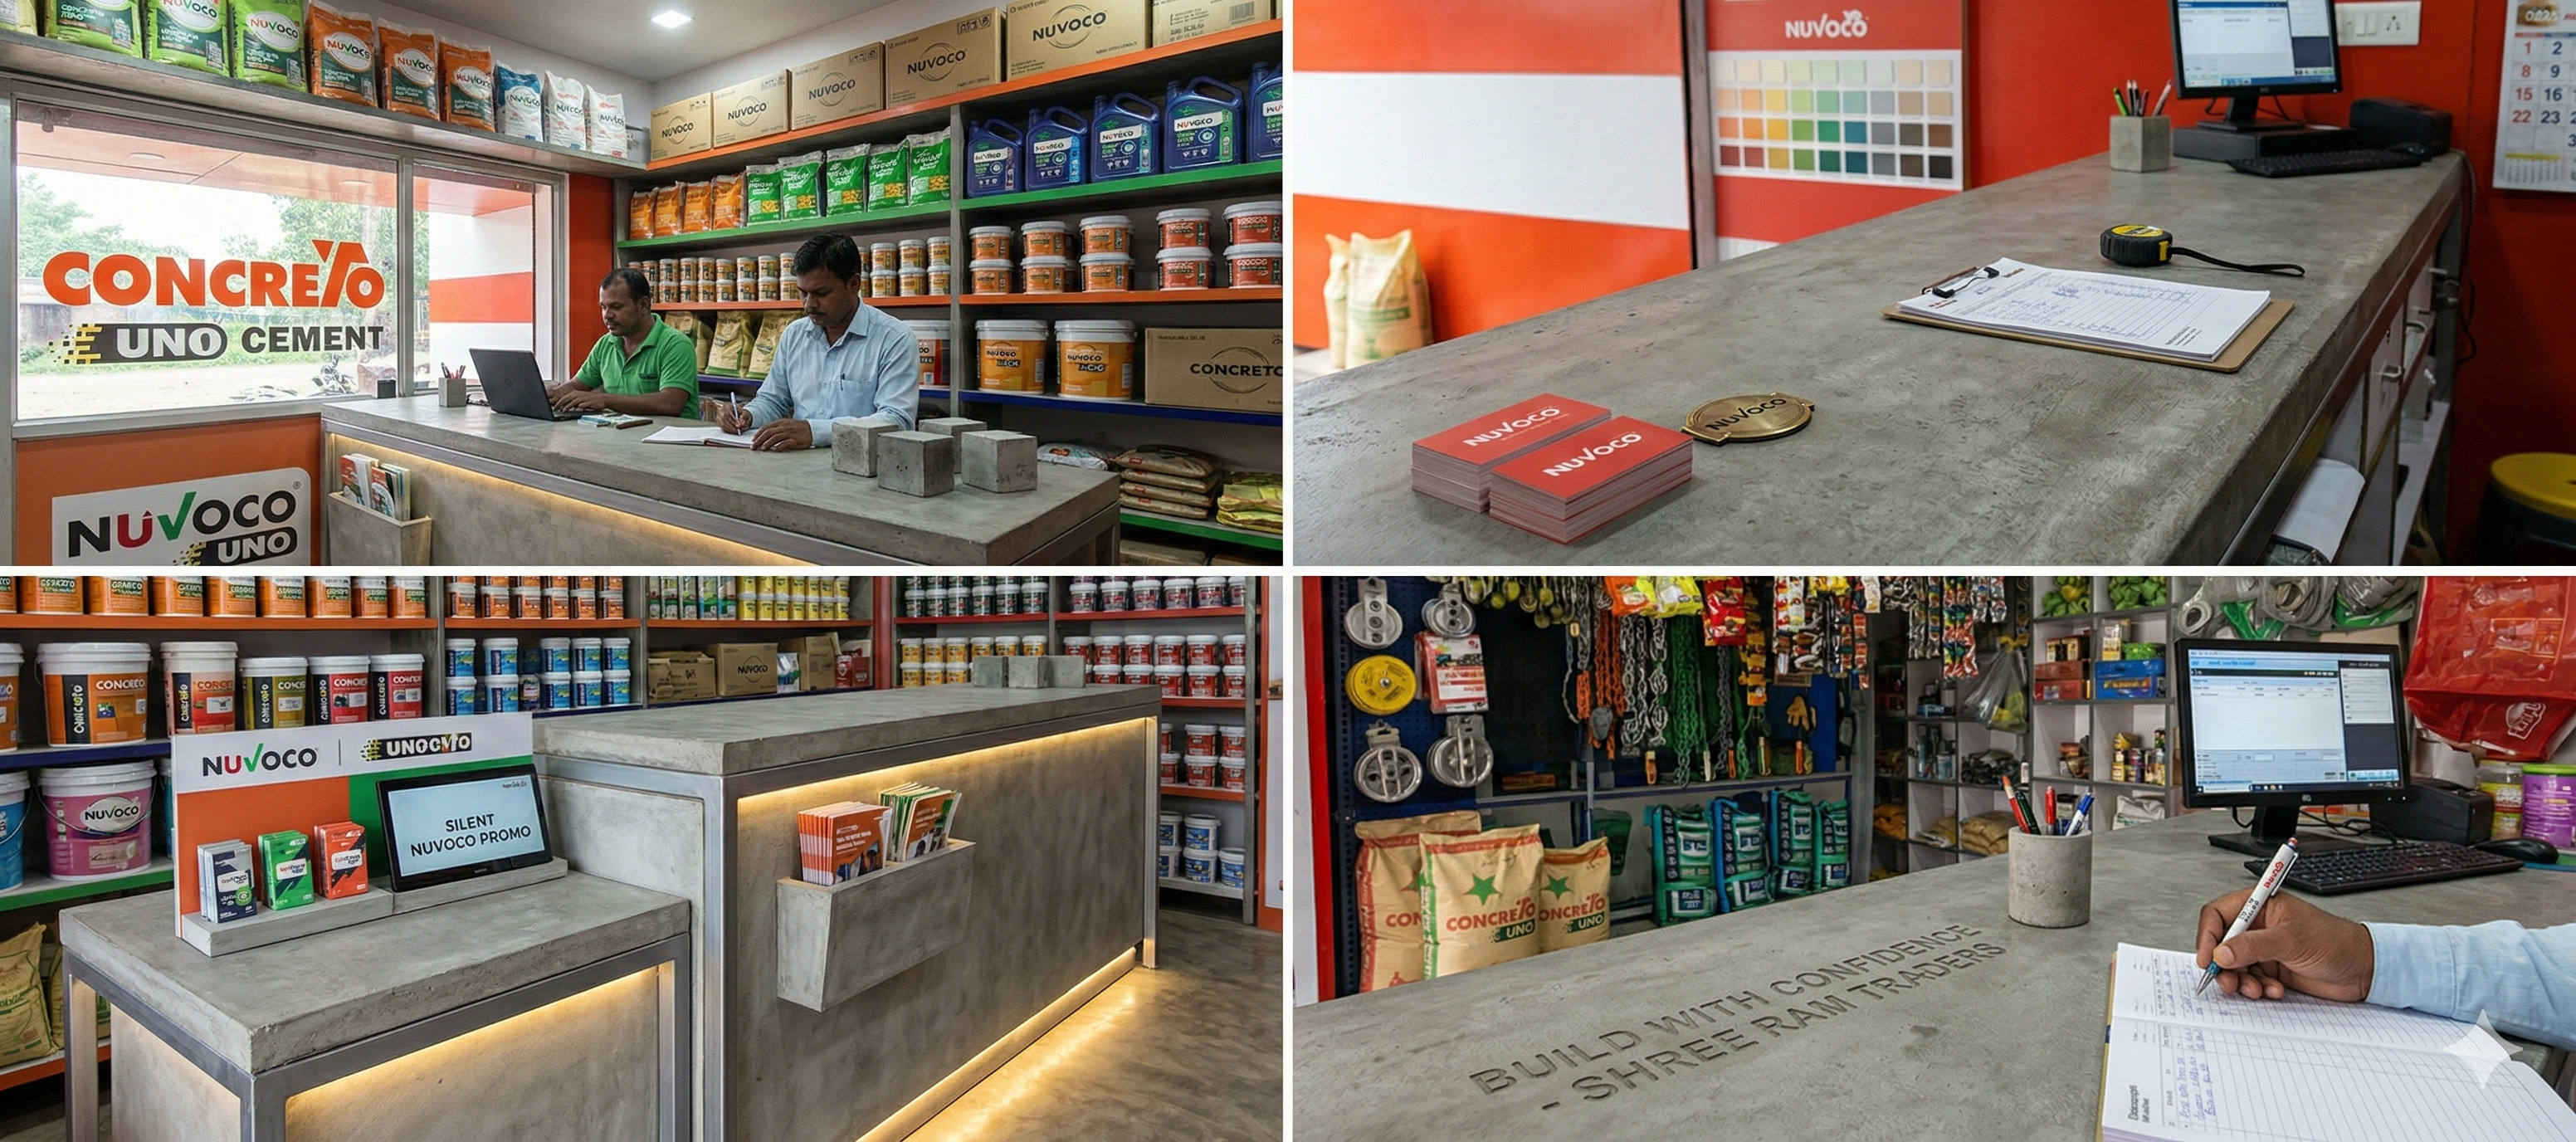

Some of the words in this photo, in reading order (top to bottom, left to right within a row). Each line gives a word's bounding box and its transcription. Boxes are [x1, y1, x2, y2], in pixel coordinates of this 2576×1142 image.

[1032, 11, 1106, 42] NUVOCO
[1784, 12, 1868, 38] NUVOCO
[2524, 41, 2531, 55] 1
[2552, 41, 2563, 55] 2
[907, 50, 966, 76] NUVOCO
[2521, 65, 2530, 78] 8
[2550, 65, 2560, 78] 9
[808, 78, 856, 100] NUVOCO
[2515, 88, 2533, 100] 15
[2544, 88, 2563, 101] 16
[727, 101, 767, 121] NUVOCO
[2512, 110, 2531, 124] 22
[2540, 110, 2561, 124] 23
[661, 121, 694, 139] NUVOCO
[42, 239, 385, 309] CONCRETO
[116, 327, 222, 359] UNO
[241, 325, 384, 353] CEMENT
[1463, 407, 1561, 447] NUVOCO
[1705, 397, 1787, 432] NUVOCO
[1542, 432, 1642, 477] NUVOCO
[67, 490, 296, 559] NUVOCO
[217, 530, 291, 564] UNO
[202, 743, 318, 777] NUVOCO
[85, 805, 139, 821] NUVOCO
[445, 813, 495, 832] SILENT
[410, 834, 476, 857] NUVOCO
[480, 825, 532, 845] PROMO
[1446, 896, 1535, 932] CONCRETO
[1539, 893, 1606, 922] ONCRETO
[1578, 914, 1604, 930] UNO
[1505, 921, 1534, 939] UNO
[1470, 1029, 1642, 1096] BUILD
[1644, 990, 1771, 1037] WITH
[1769, 925, 1983, 996] CONFIDENCE
[1571, 1028, 1760, 1103] SHREE
[1751, 994, 1858, 1038] RAM
[1848, 942, 2008, 1000] TRADERS
